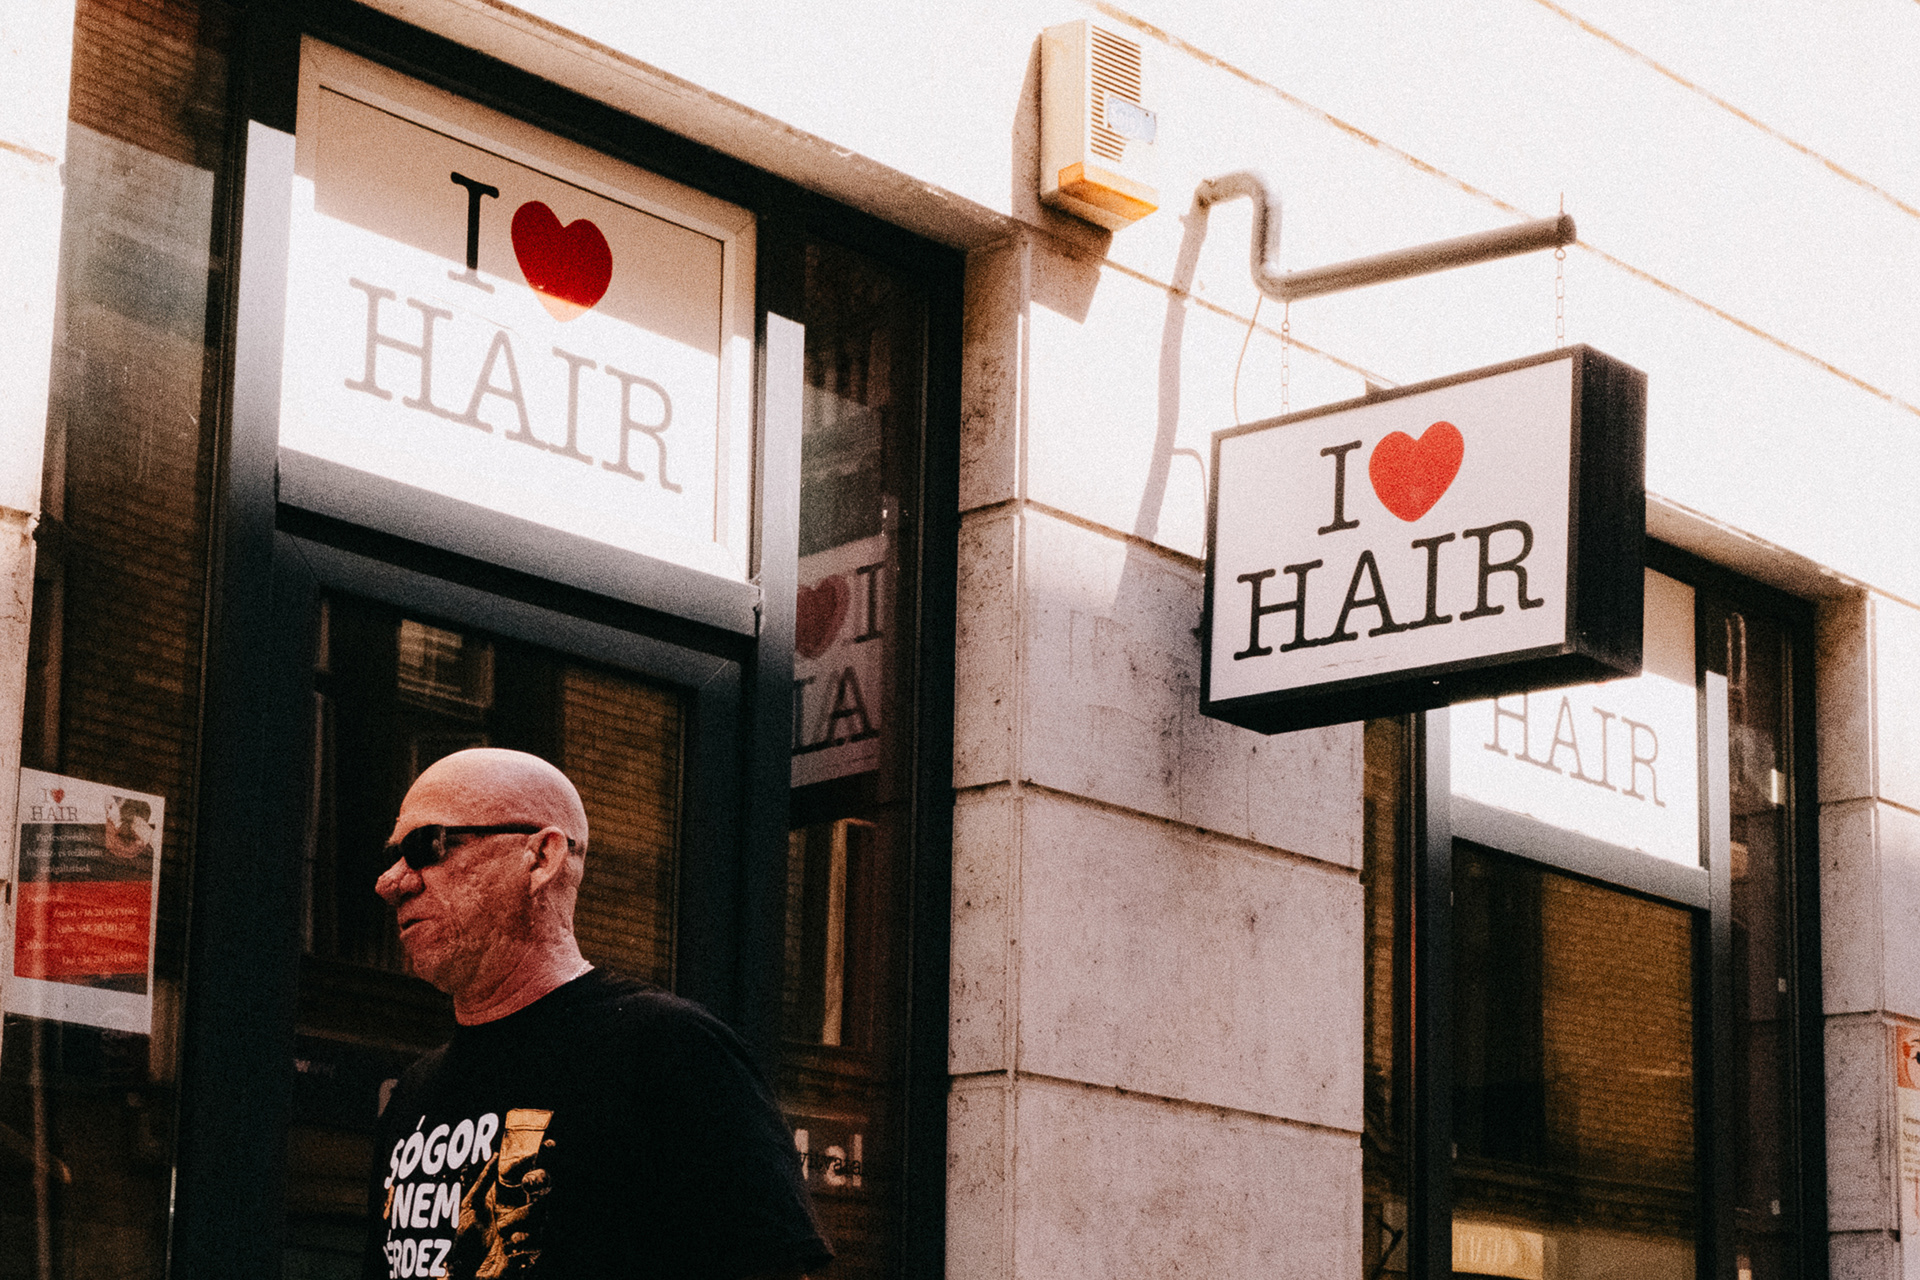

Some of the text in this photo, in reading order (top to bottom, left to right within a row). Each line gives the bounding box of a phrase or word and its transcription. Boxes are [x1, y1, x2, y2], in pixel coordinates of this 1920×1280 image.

[449, 171, 500, 293] I
[344, 276, 683, 494] HAIR
[1317, 439, 1363, 536] I
[1232, 519, 1545, 661] HAIR
[1484, 693, 1666, 808] HAIR
[30, 805, 79, 822] HAIR
[391, 1182, 462, 1230] NEM
